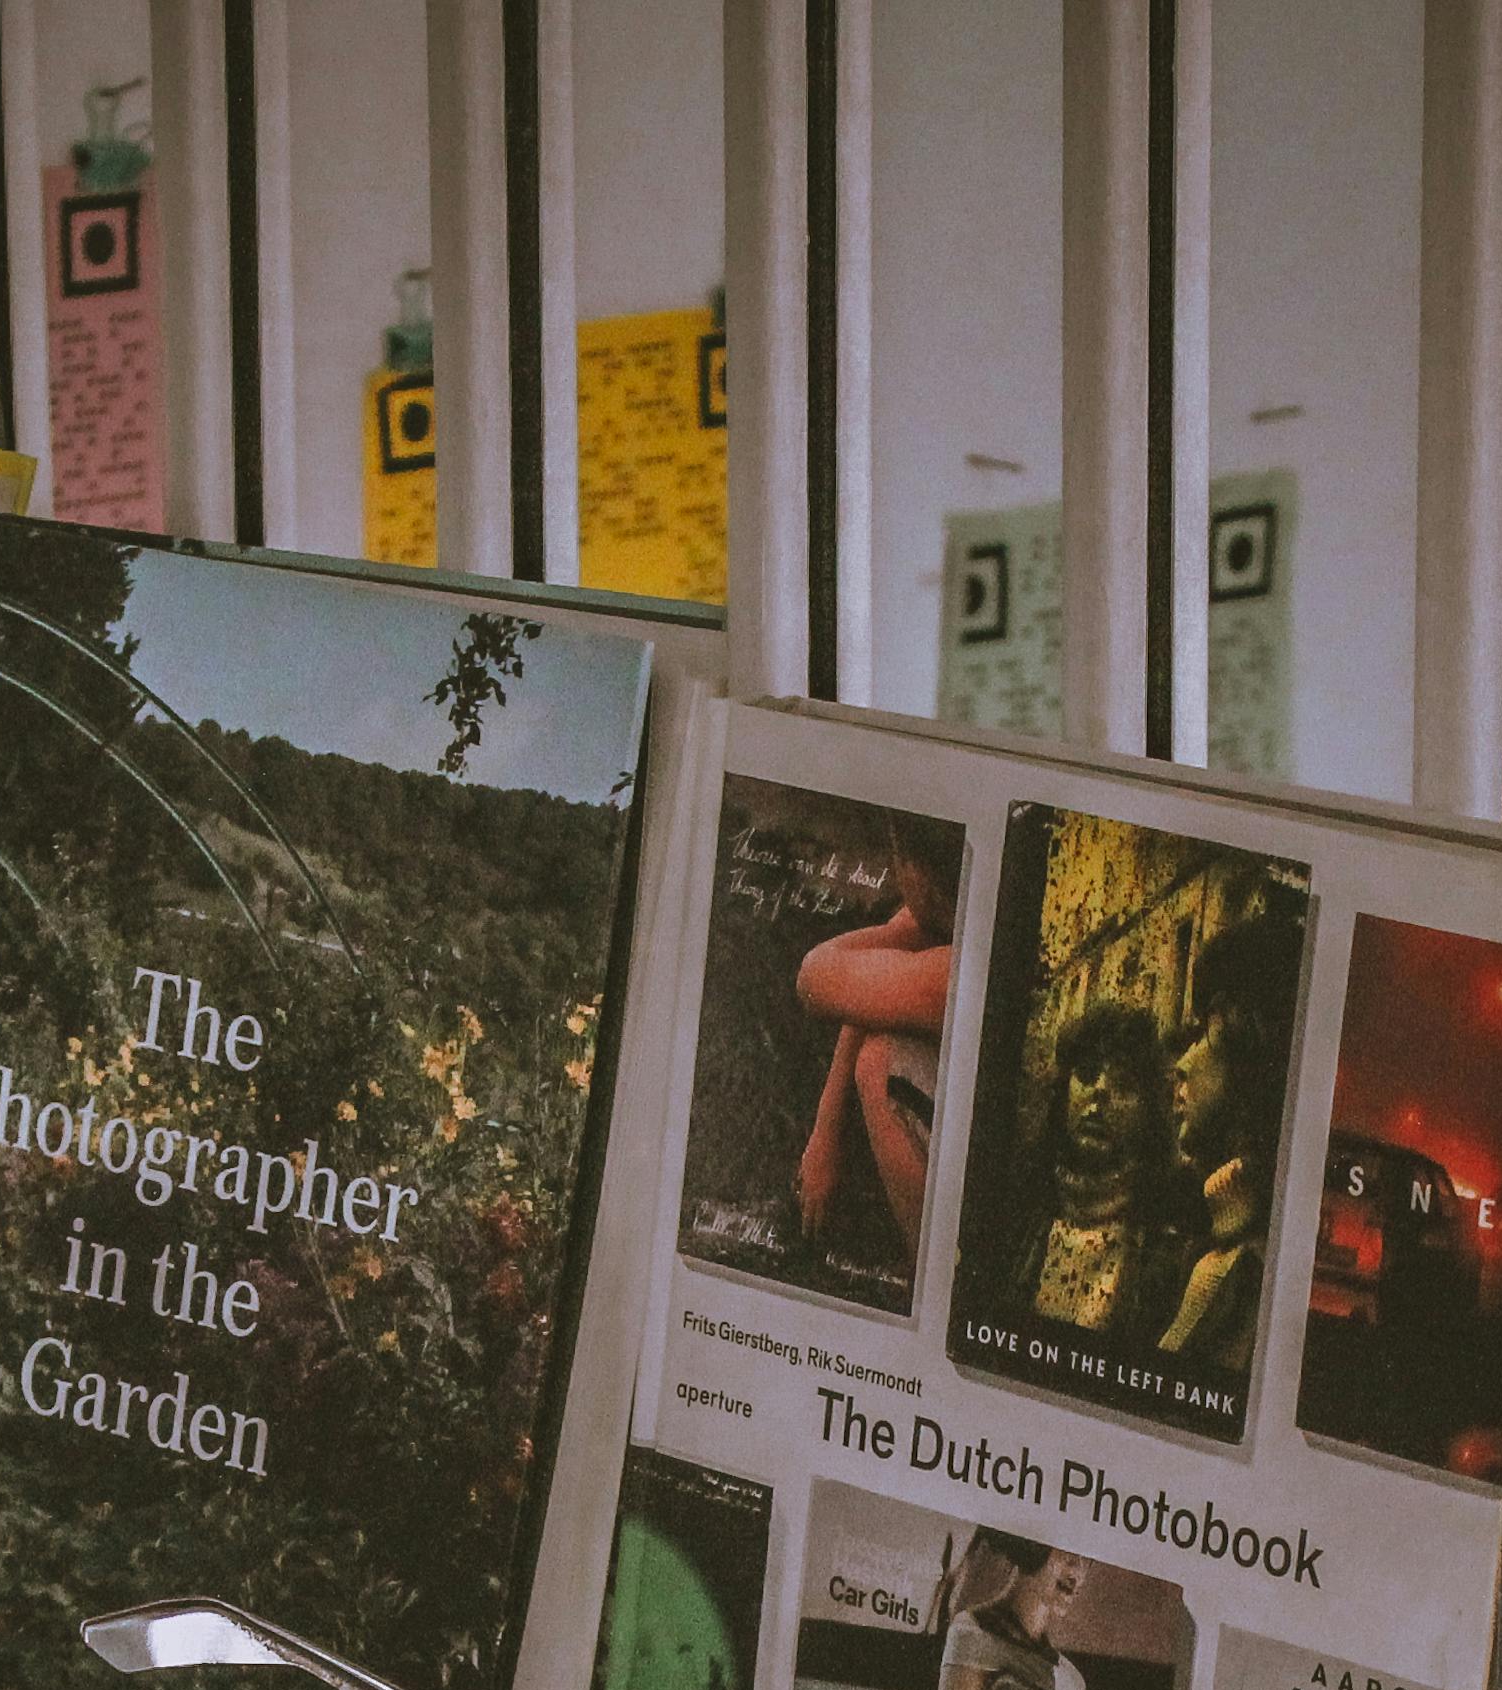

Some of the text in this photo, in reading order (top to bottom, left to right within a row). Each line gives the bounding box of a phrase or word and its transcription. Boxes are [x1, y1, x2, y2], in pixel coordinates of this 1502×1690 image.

[132, 966, 264, 1072] The
[60, 1217, 262, 1338] in the
[676, 1381, 753, 1419] aperture
[683, 1310, 924, 1398] Frits Gierstberg, Rik Suermondt
[964, 1320, 1239, 1418] LOVE ON THE LEFT BANK
[20, 1337, 270, 1478] Garden
[816, 1387, 1325, 1590] The Dutch Photobook
[829, 1575, 920, 1627] Car Girls
